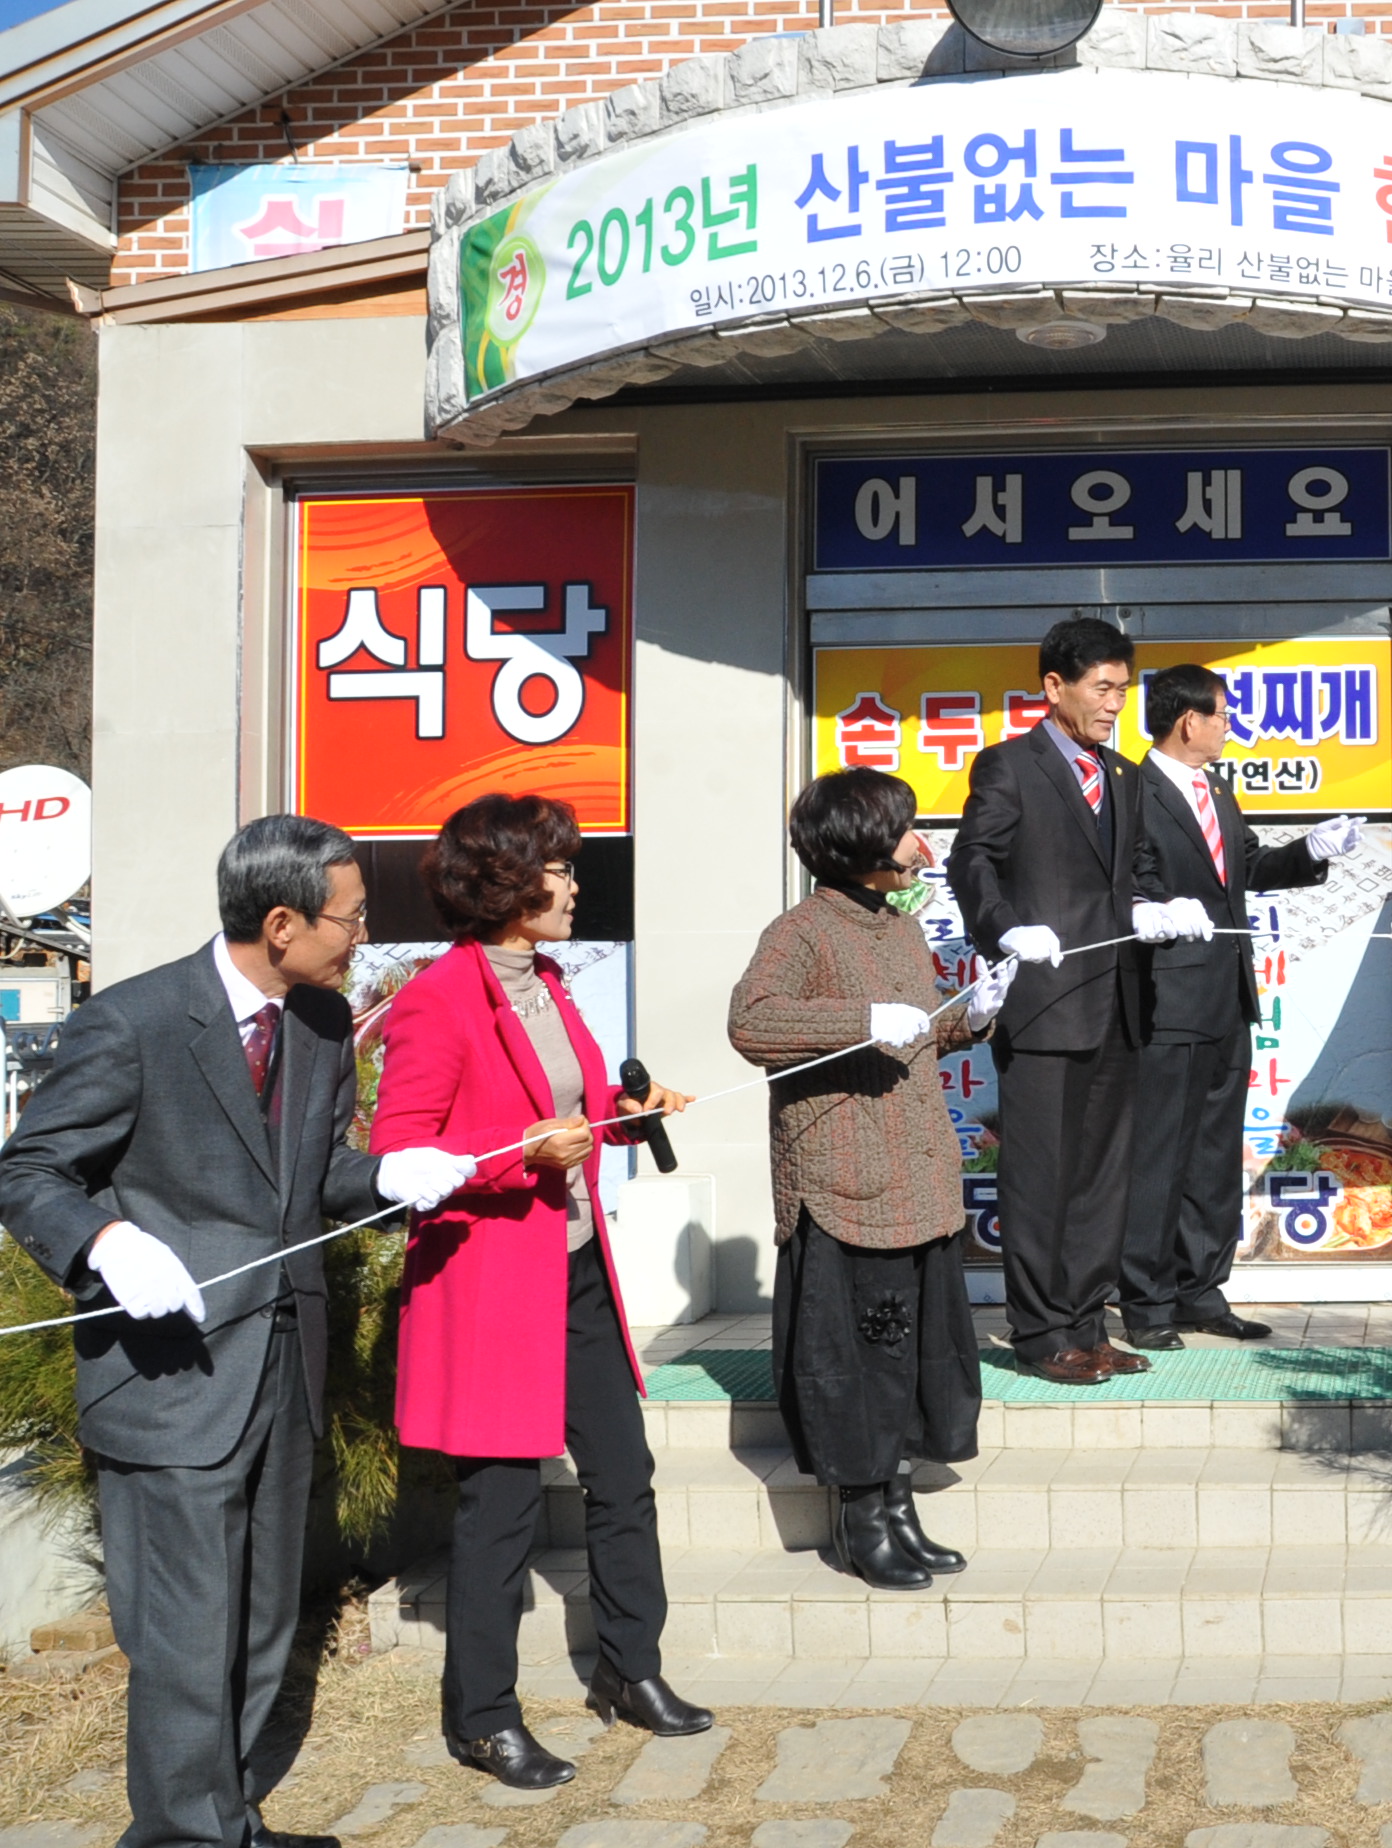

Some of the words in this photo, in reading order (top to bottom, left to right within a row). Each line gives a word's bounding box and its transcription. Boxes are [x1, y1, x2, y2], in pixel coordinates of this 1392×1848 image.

[565, 162, 758, 300] 2013년
[794, 128, 1135, 243] 산불없는
[1174, 134, 1341, 236] 마을
[497, 252, 530, 322] 경
[939, 245, 1023, 278] 12:00
[1235, 249, 1349, 290] 산불없는
[317, 580, 609, 746] 식당
[1143, 668, 1376, 744] 섯찌개
[0, 796, 71, 823] HD
